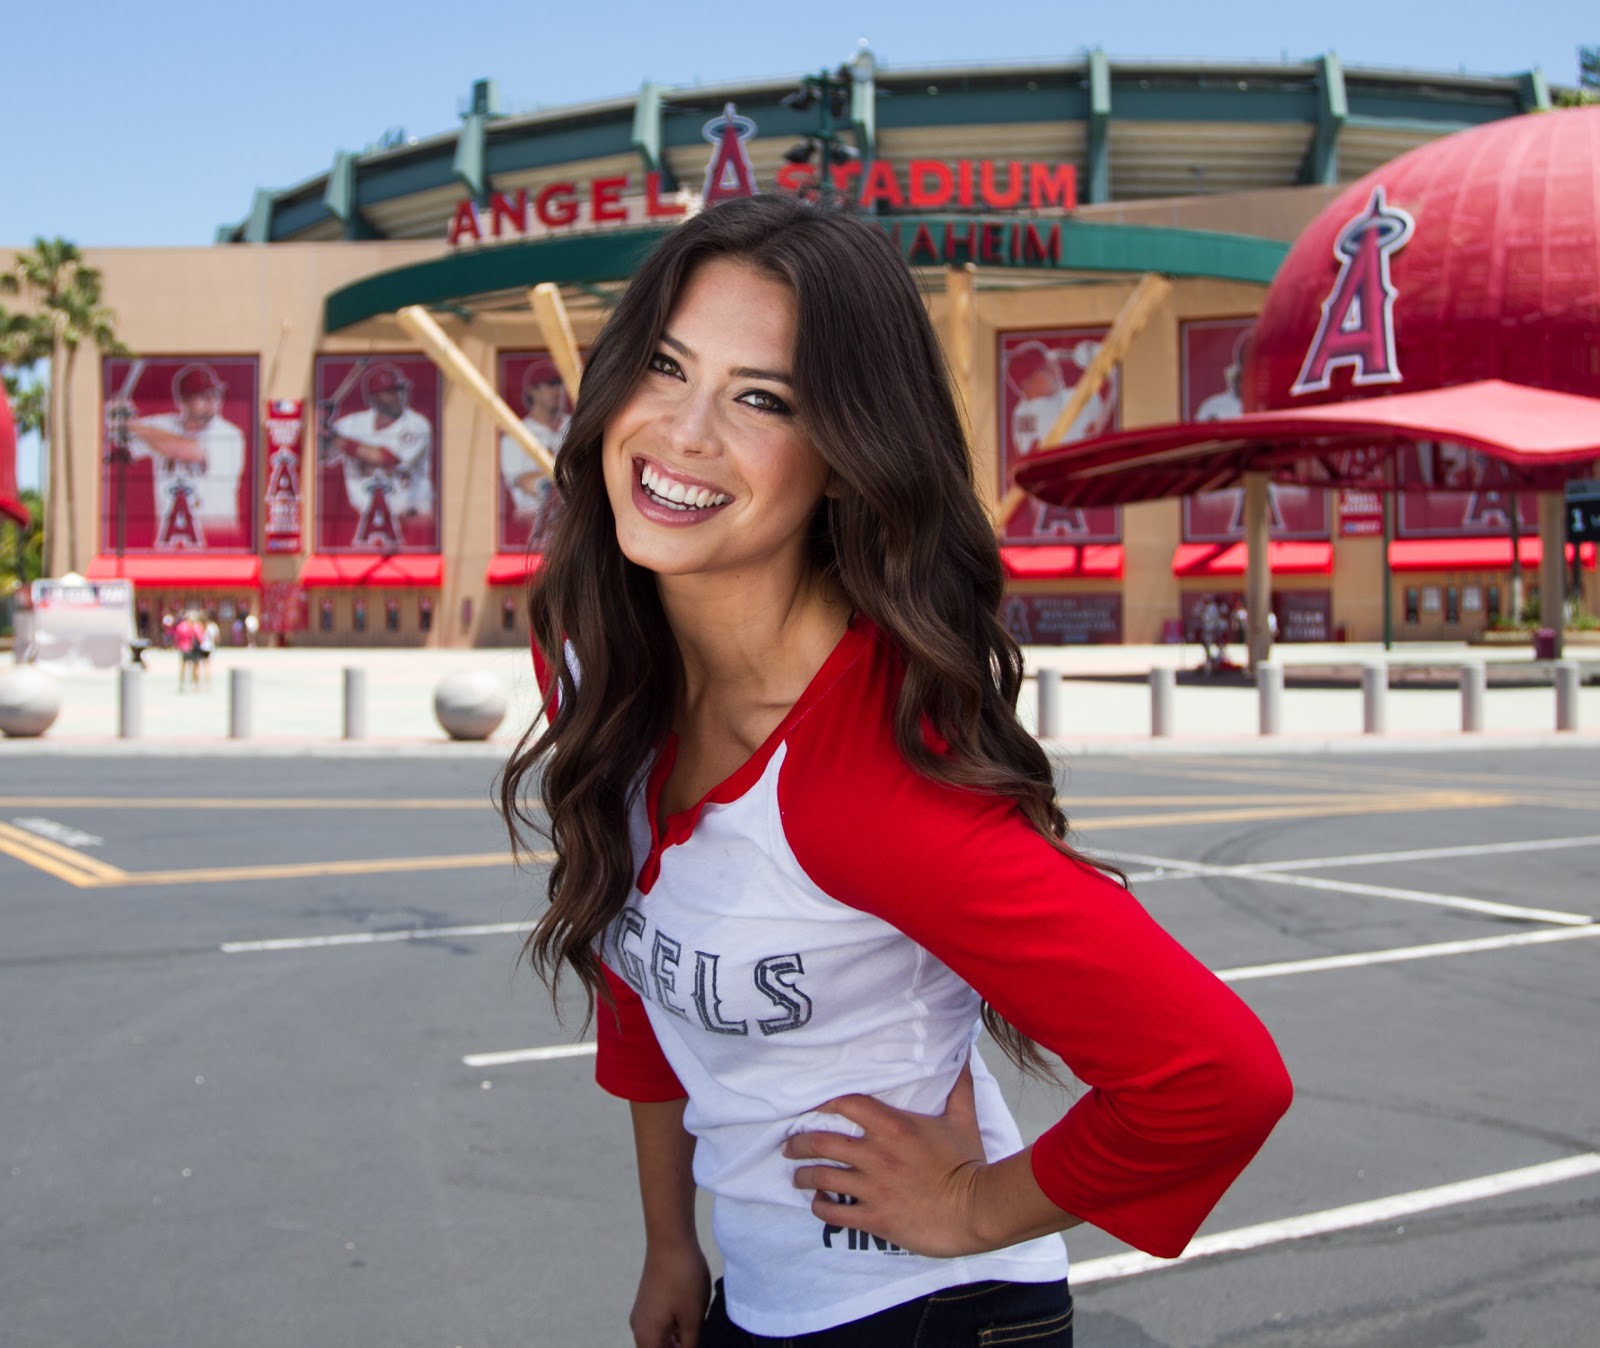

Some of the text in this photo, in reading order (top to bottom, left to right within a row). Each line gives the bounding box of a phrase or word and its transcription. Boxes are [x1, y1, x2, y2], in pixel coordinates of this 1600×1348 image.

[776, 158, 1077, 212] STADIUM
[872, 221, 1062, 263] AHEIM
[594, 906, 812, 1036] GELS
[822, 1223, 900, 1251] PIN
